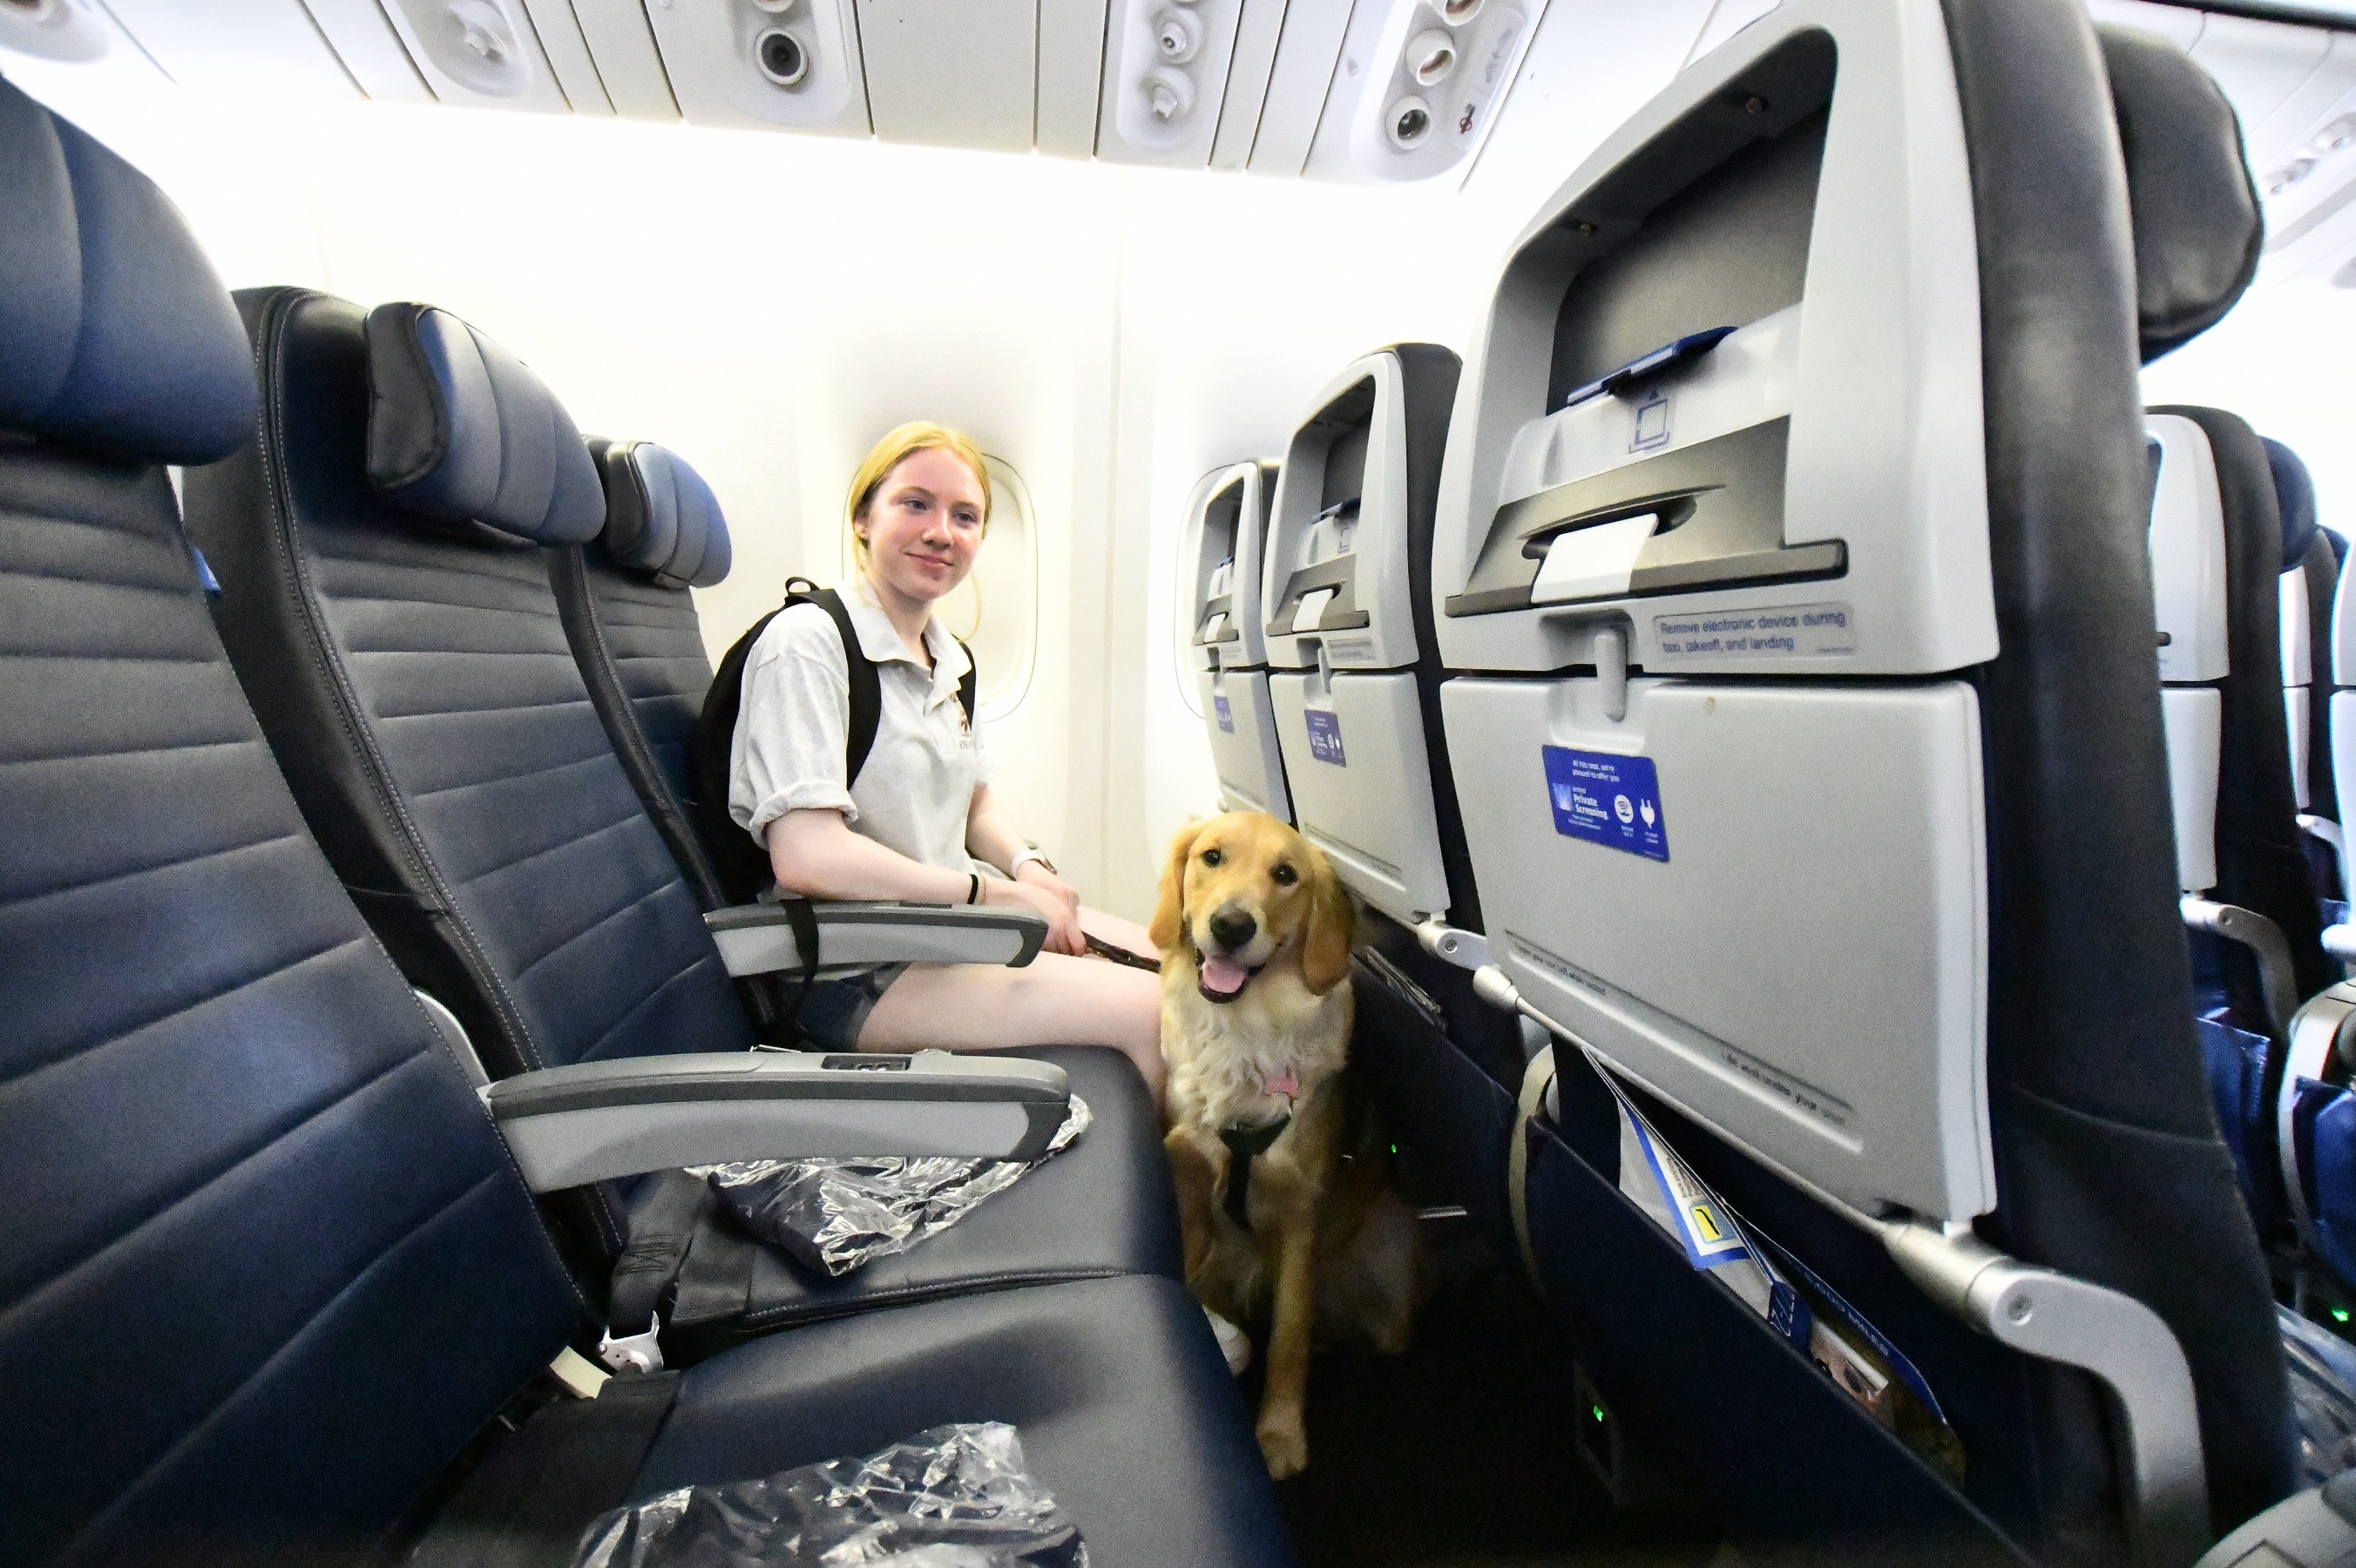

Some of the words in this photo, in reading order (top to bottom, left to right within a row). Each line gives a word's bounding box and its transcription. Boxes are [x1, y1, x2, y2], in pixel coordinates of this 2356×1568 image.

[1661, 623, 1700, 634] Remove
[1703, 618, 1755, 632] electronic
[1758, 616, 1798, 628] device
[1803, 612, 1846, 627] during
[1725, 637, 1747, 650] and
[1750, 637, 1794, 652] landing
[1573, 794, 1598, 807] Private
[1575, 804, 1608, 821] Screening
